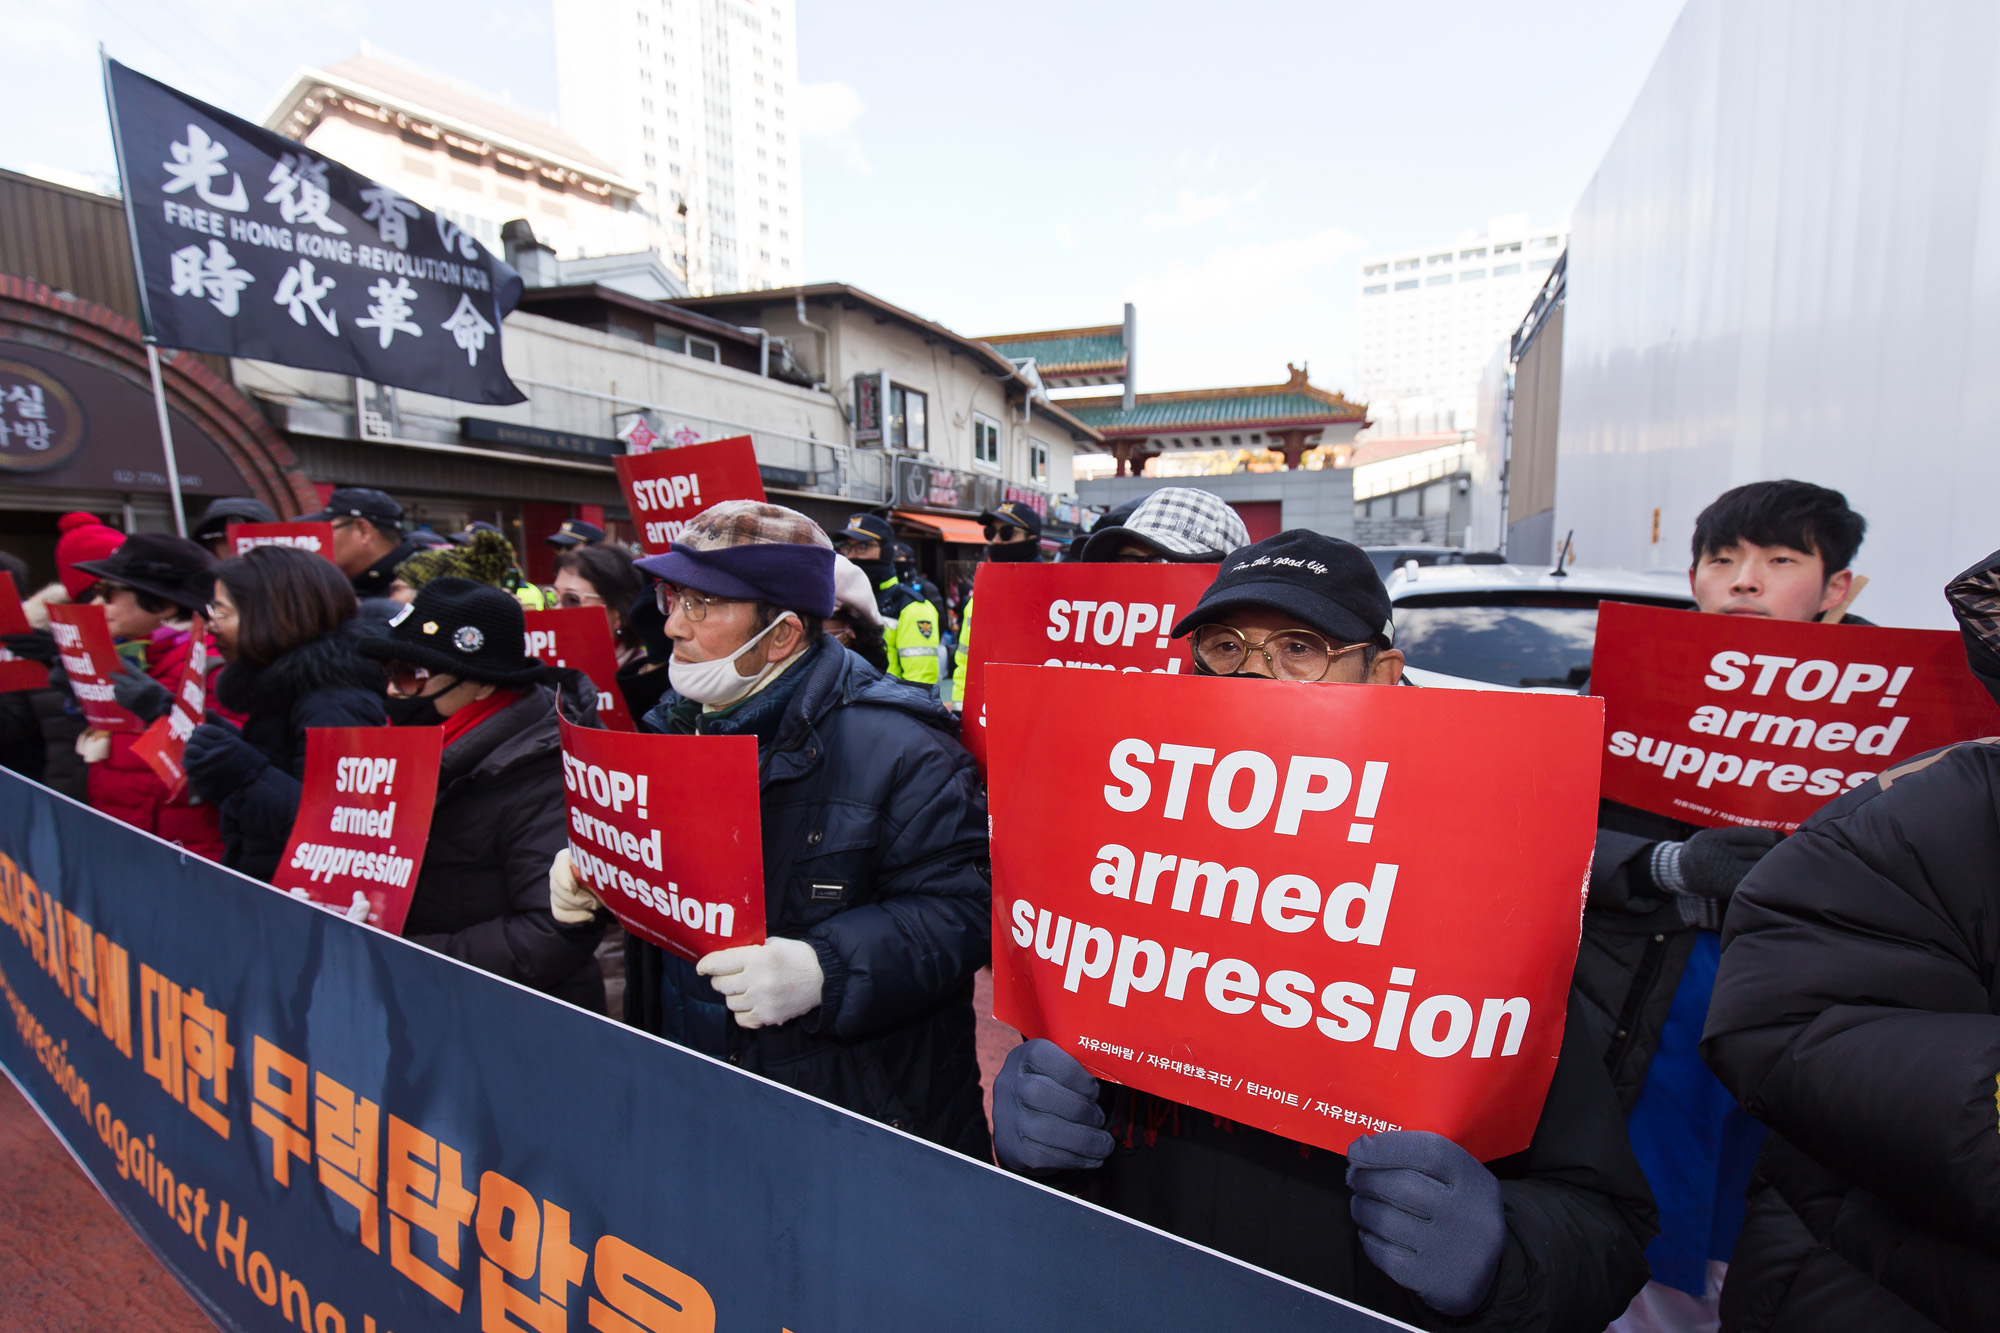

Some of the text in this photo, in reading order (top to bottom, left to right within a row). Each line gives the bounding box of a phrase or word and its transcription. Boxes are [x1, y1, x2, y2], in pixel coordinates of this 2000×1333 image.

[163, 200, 226, 237] FREE
[230, 217, 293, 251] HONG
[462, 264, 492, 291] NOW
[170, 239, 496, 367] 時代革命
[632, 473, 702, 511] STOP!
[1272, 557, 1305, 568] good
[1306, 561, 1328, 574] life
[1047, 600, 1176, 648] STOP!
[1704, 650, 1915, 708] STOP!
[1688, 704, 1910, 756] armed
[336, 756, 397, 795] STOP!
[562, 750, 648, 819] STOP!
[1104, 738, 1389, 843] STOP!
[330, 801, 396, 838] armed
[571, 805, 663, 871] armed
[291, 842, 413, 888] suppression
[567, 837, 735, 938] uppression
[1090, 843, 1399, 946] armed
[1011, 899, 1531, 1059] suppression
[140, 963, 235, 1140] 대한
[1078, 1035, 1135, 1061] 자유의바람
[1146, 1053, 1233, 1088] 자유대한호국단
[1246, 1081, 1300, 1107] 턴라이트
[95, 1103, 210, 1251] against
